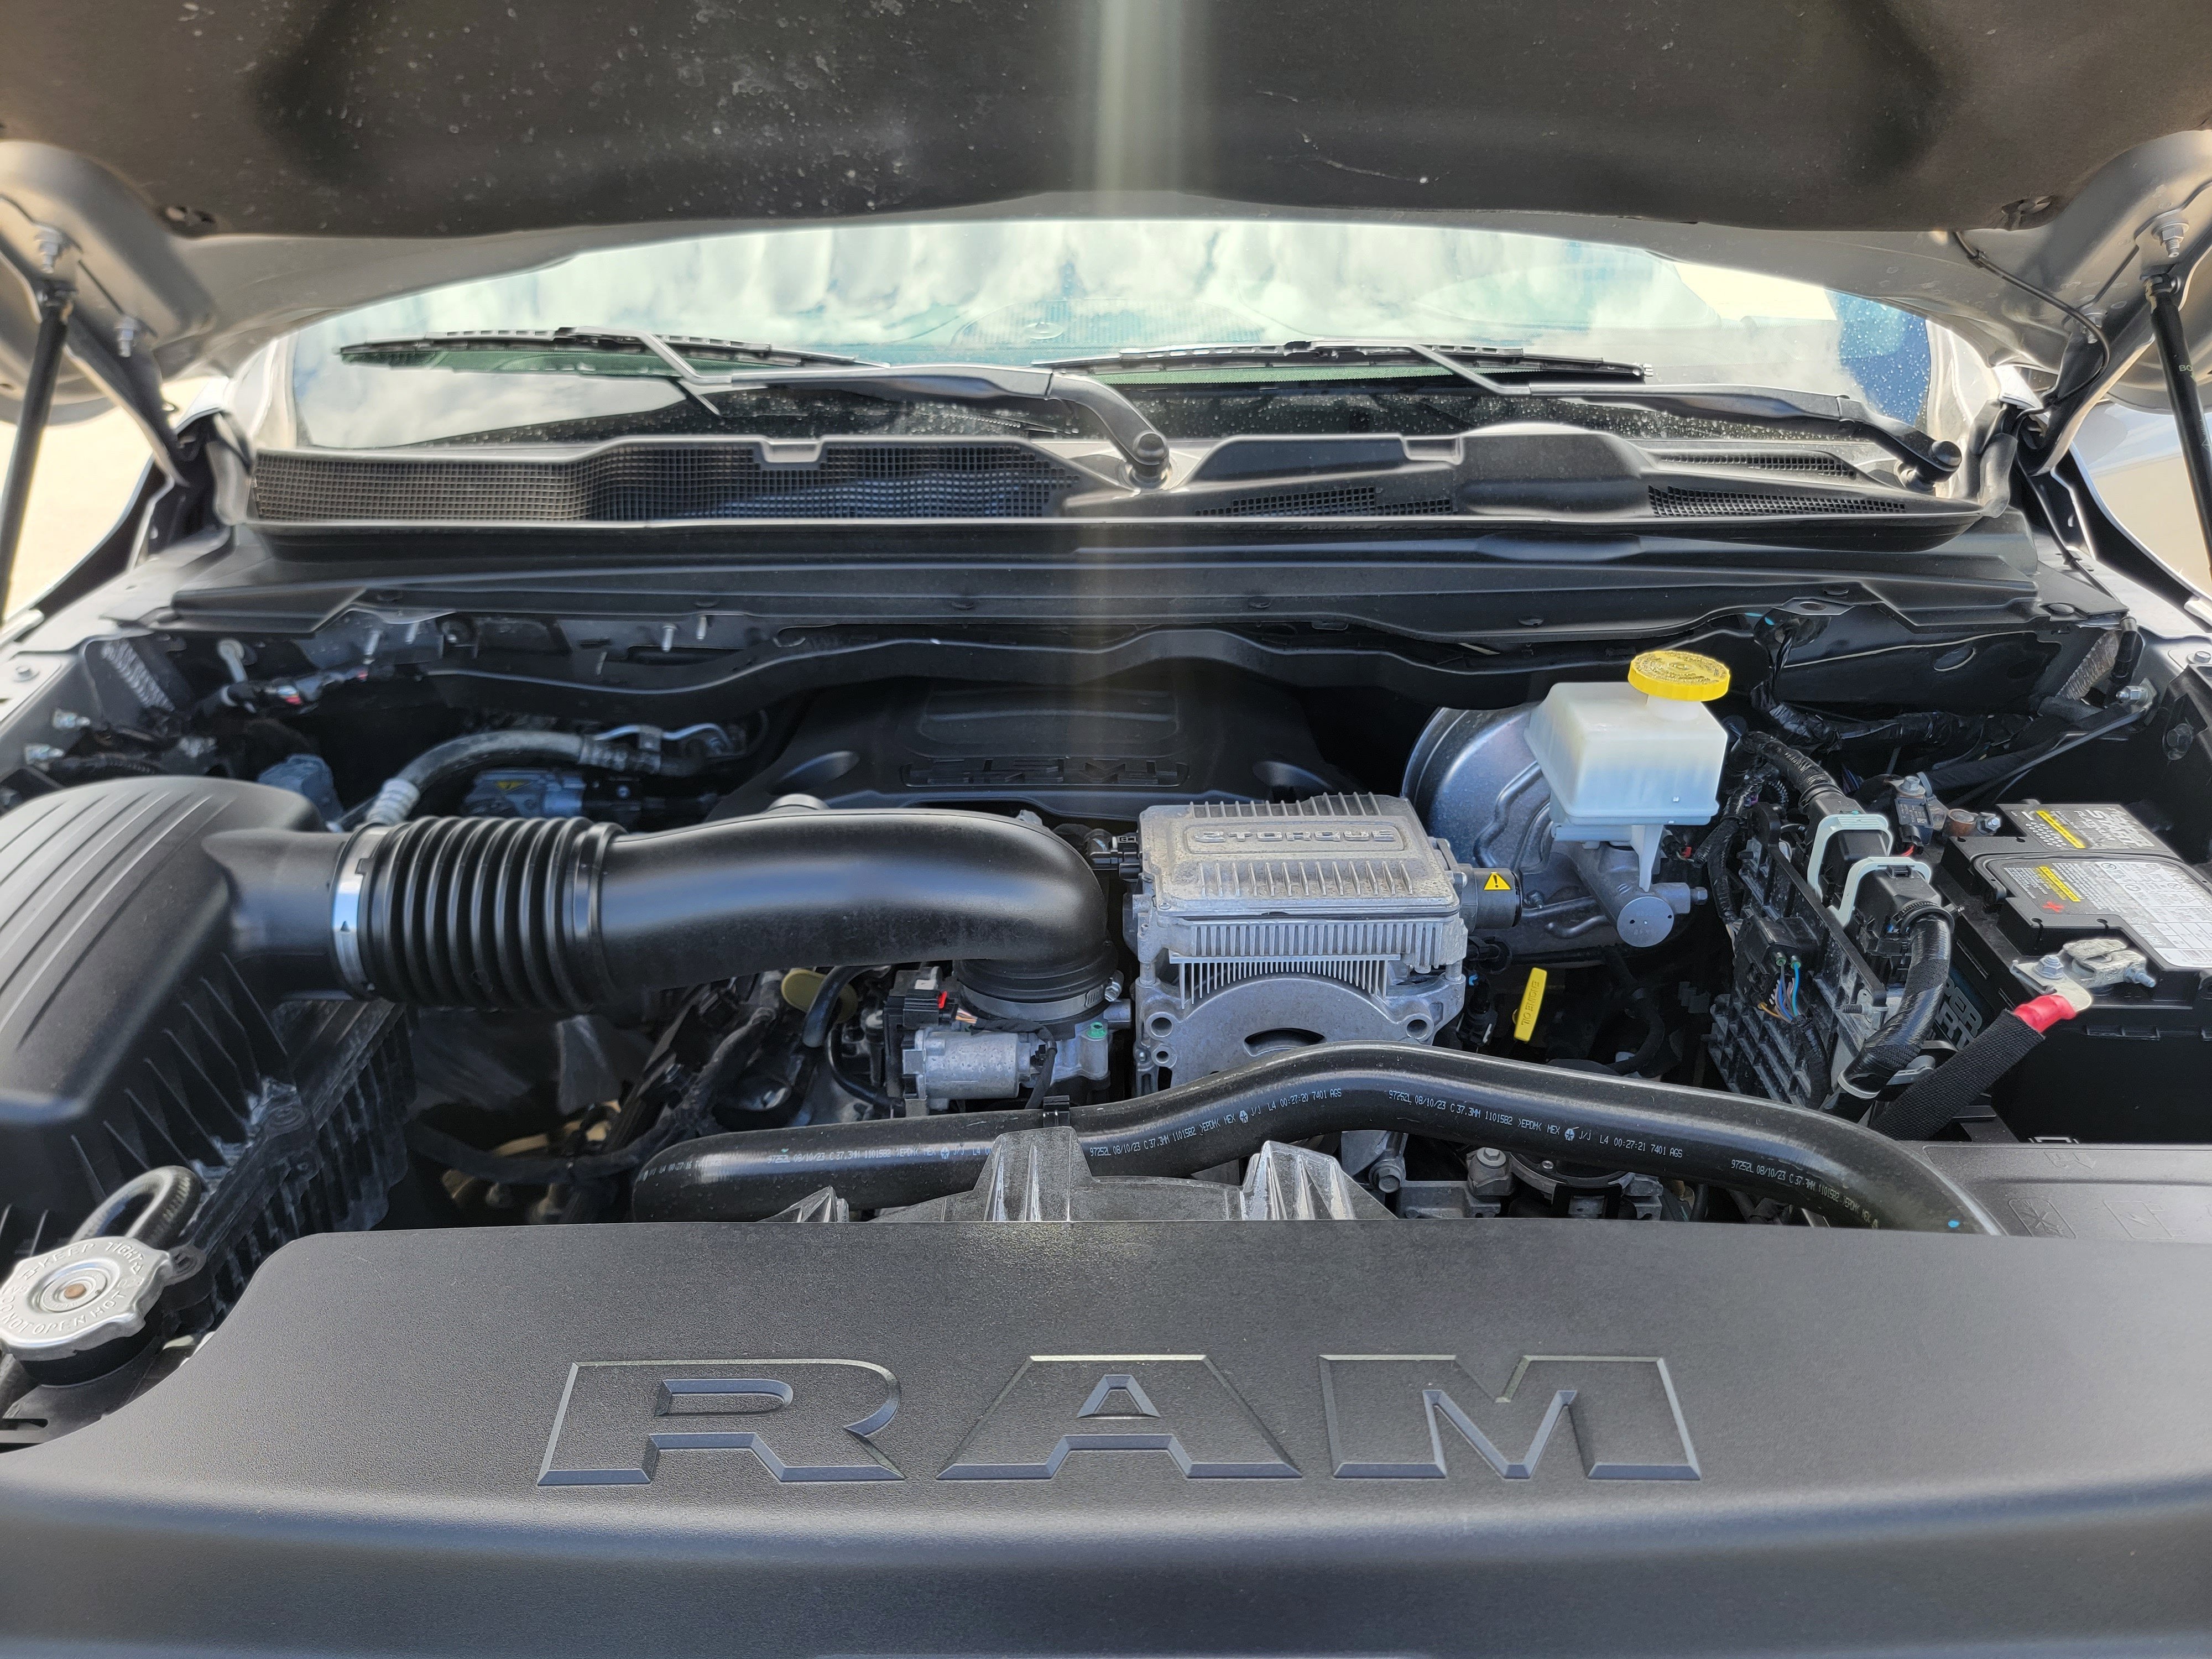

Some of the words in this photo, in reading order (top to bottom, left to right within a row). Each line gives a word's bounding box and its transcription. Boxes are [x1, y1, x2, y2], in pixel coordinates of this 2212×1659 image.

[2074, 810, 2115, 840] PLATINUM
[2085, 809, 2143, 847] START
[1526, 980, 1540, 1011] ENGINE
[1943, 977, 1982, 1037] PER
[1521, 1011, 1531, 1025] OIL
[1113, 1142, 1141, 1155] 08/10/23
[1144, 1140, 1149, 1150] C
[1150, 1135, 1170, 1149] 37.3MM
[1172, 1126, 1197, 1142] 1101582
[1224, 1113, 1237, 1125] MEX
[1267, 1100, 1276, 1112] L4
[1280, 1093, 1308, 1108] 00:27:20
[1311, 1089, 1327, 1100] 7401
[1329, 1088, 1342, 1098] AGS
[1415, 1095, 1446, 1110] 08/10/23
[1450, 1103, 1455, 1113] C
[1457, 1104, 1481, 1119] 37.3MM
[1485, 1110, 1513, 1125] 1101582
[1547, 1124, 1561, 1135] MEX
[1599, 1134, 1609, 1145] L4
[1614, 1137, 1646, 1151] 00:27:21
[1651, 1144, 1666, 1156] 7401
[1670, 1148, 1683, 1158] AGS
[794, 1152, 825, 1162] 08/10/23
[830, 1152, 834, 1161] C
[836, 1151, 860, 1160] 37.3MM
[864, 1149, 891, 1159] 1101582
[1756, 1164, 1786, 1181] 08/10/23
[1789, 1173, 1794, 1183] C
[2, 1312, 34, 1333] NOT
[90, 1290, 126, 1318] HOT
[536, 1354, 1703, 1482] RAM
